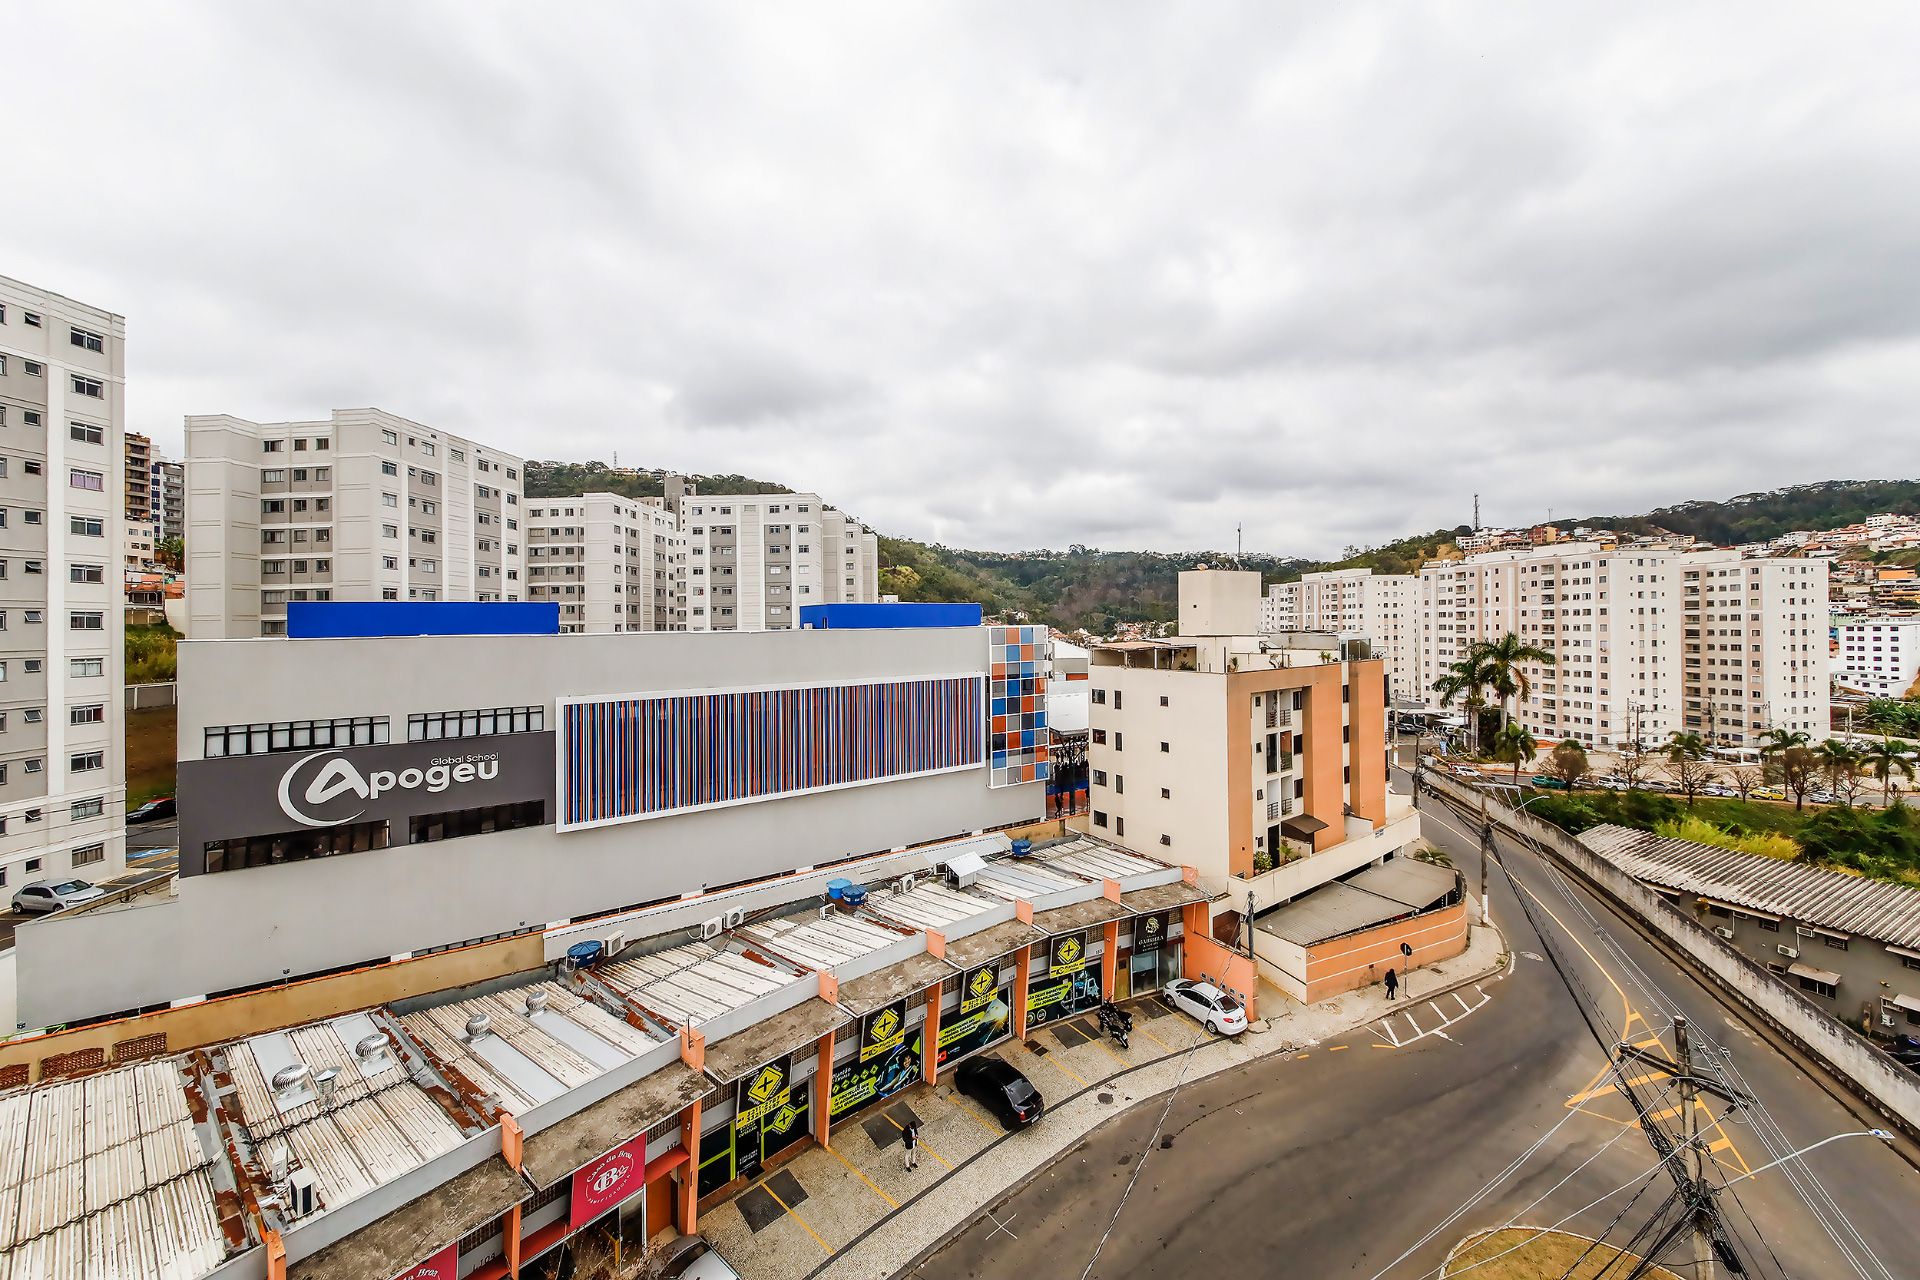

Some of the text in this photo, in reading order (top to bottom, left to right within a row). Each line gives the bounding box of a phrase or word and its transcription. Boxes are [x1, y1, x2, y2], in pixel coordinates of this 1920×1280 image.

[430, 752, 499, 766] Global School
[304, 758, 499, 805] Apogeu
